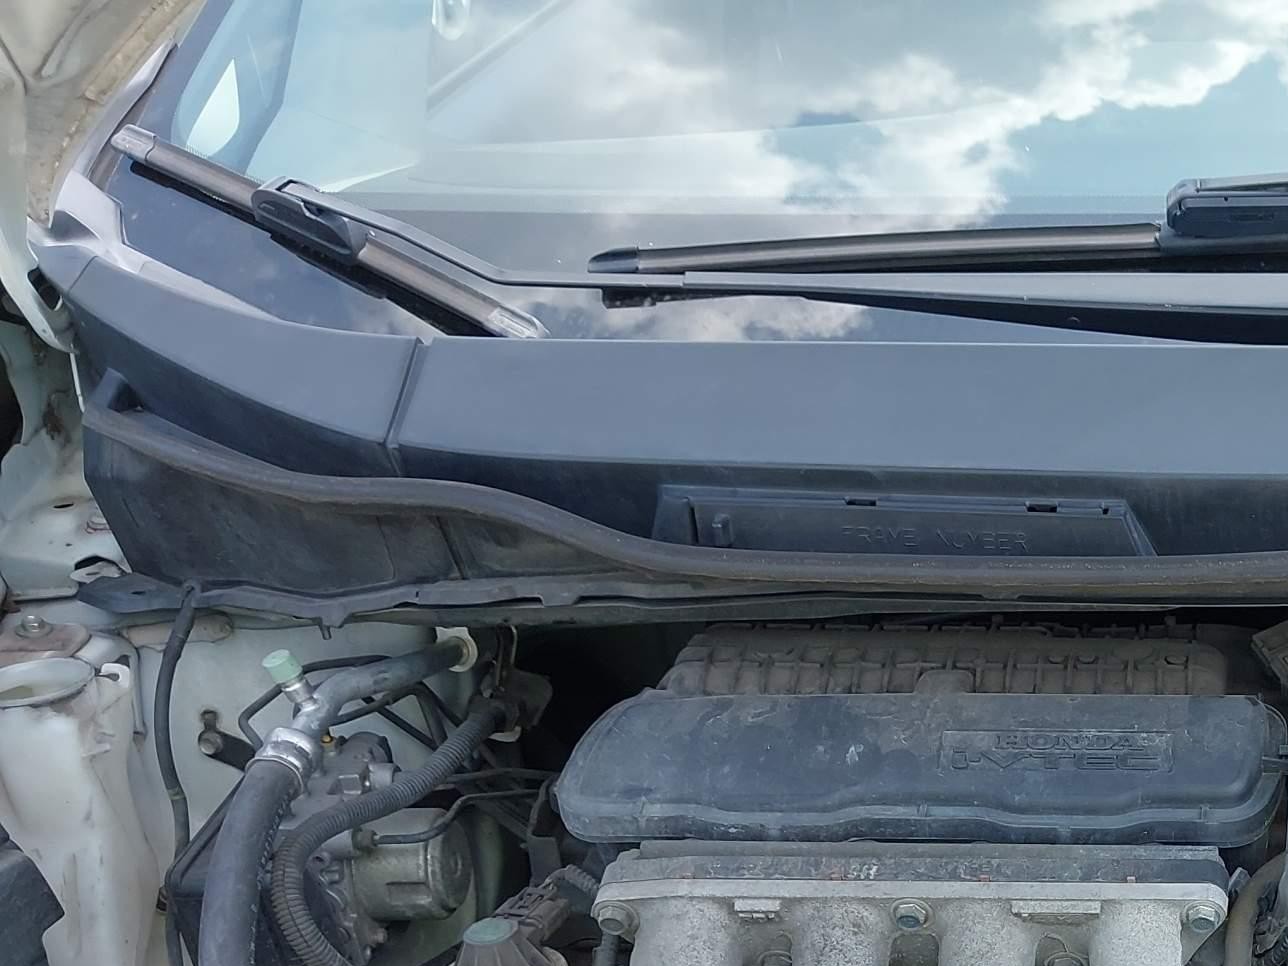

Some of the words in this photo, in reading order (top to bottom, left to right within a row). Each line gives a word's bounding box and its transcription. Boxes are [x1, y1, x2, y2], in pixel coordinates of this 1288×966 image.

[841, 526, 919, 547] FRAME
[935, 529, 1029, 552] NUMBER
[993, 733, 1145, 751] HONDA
